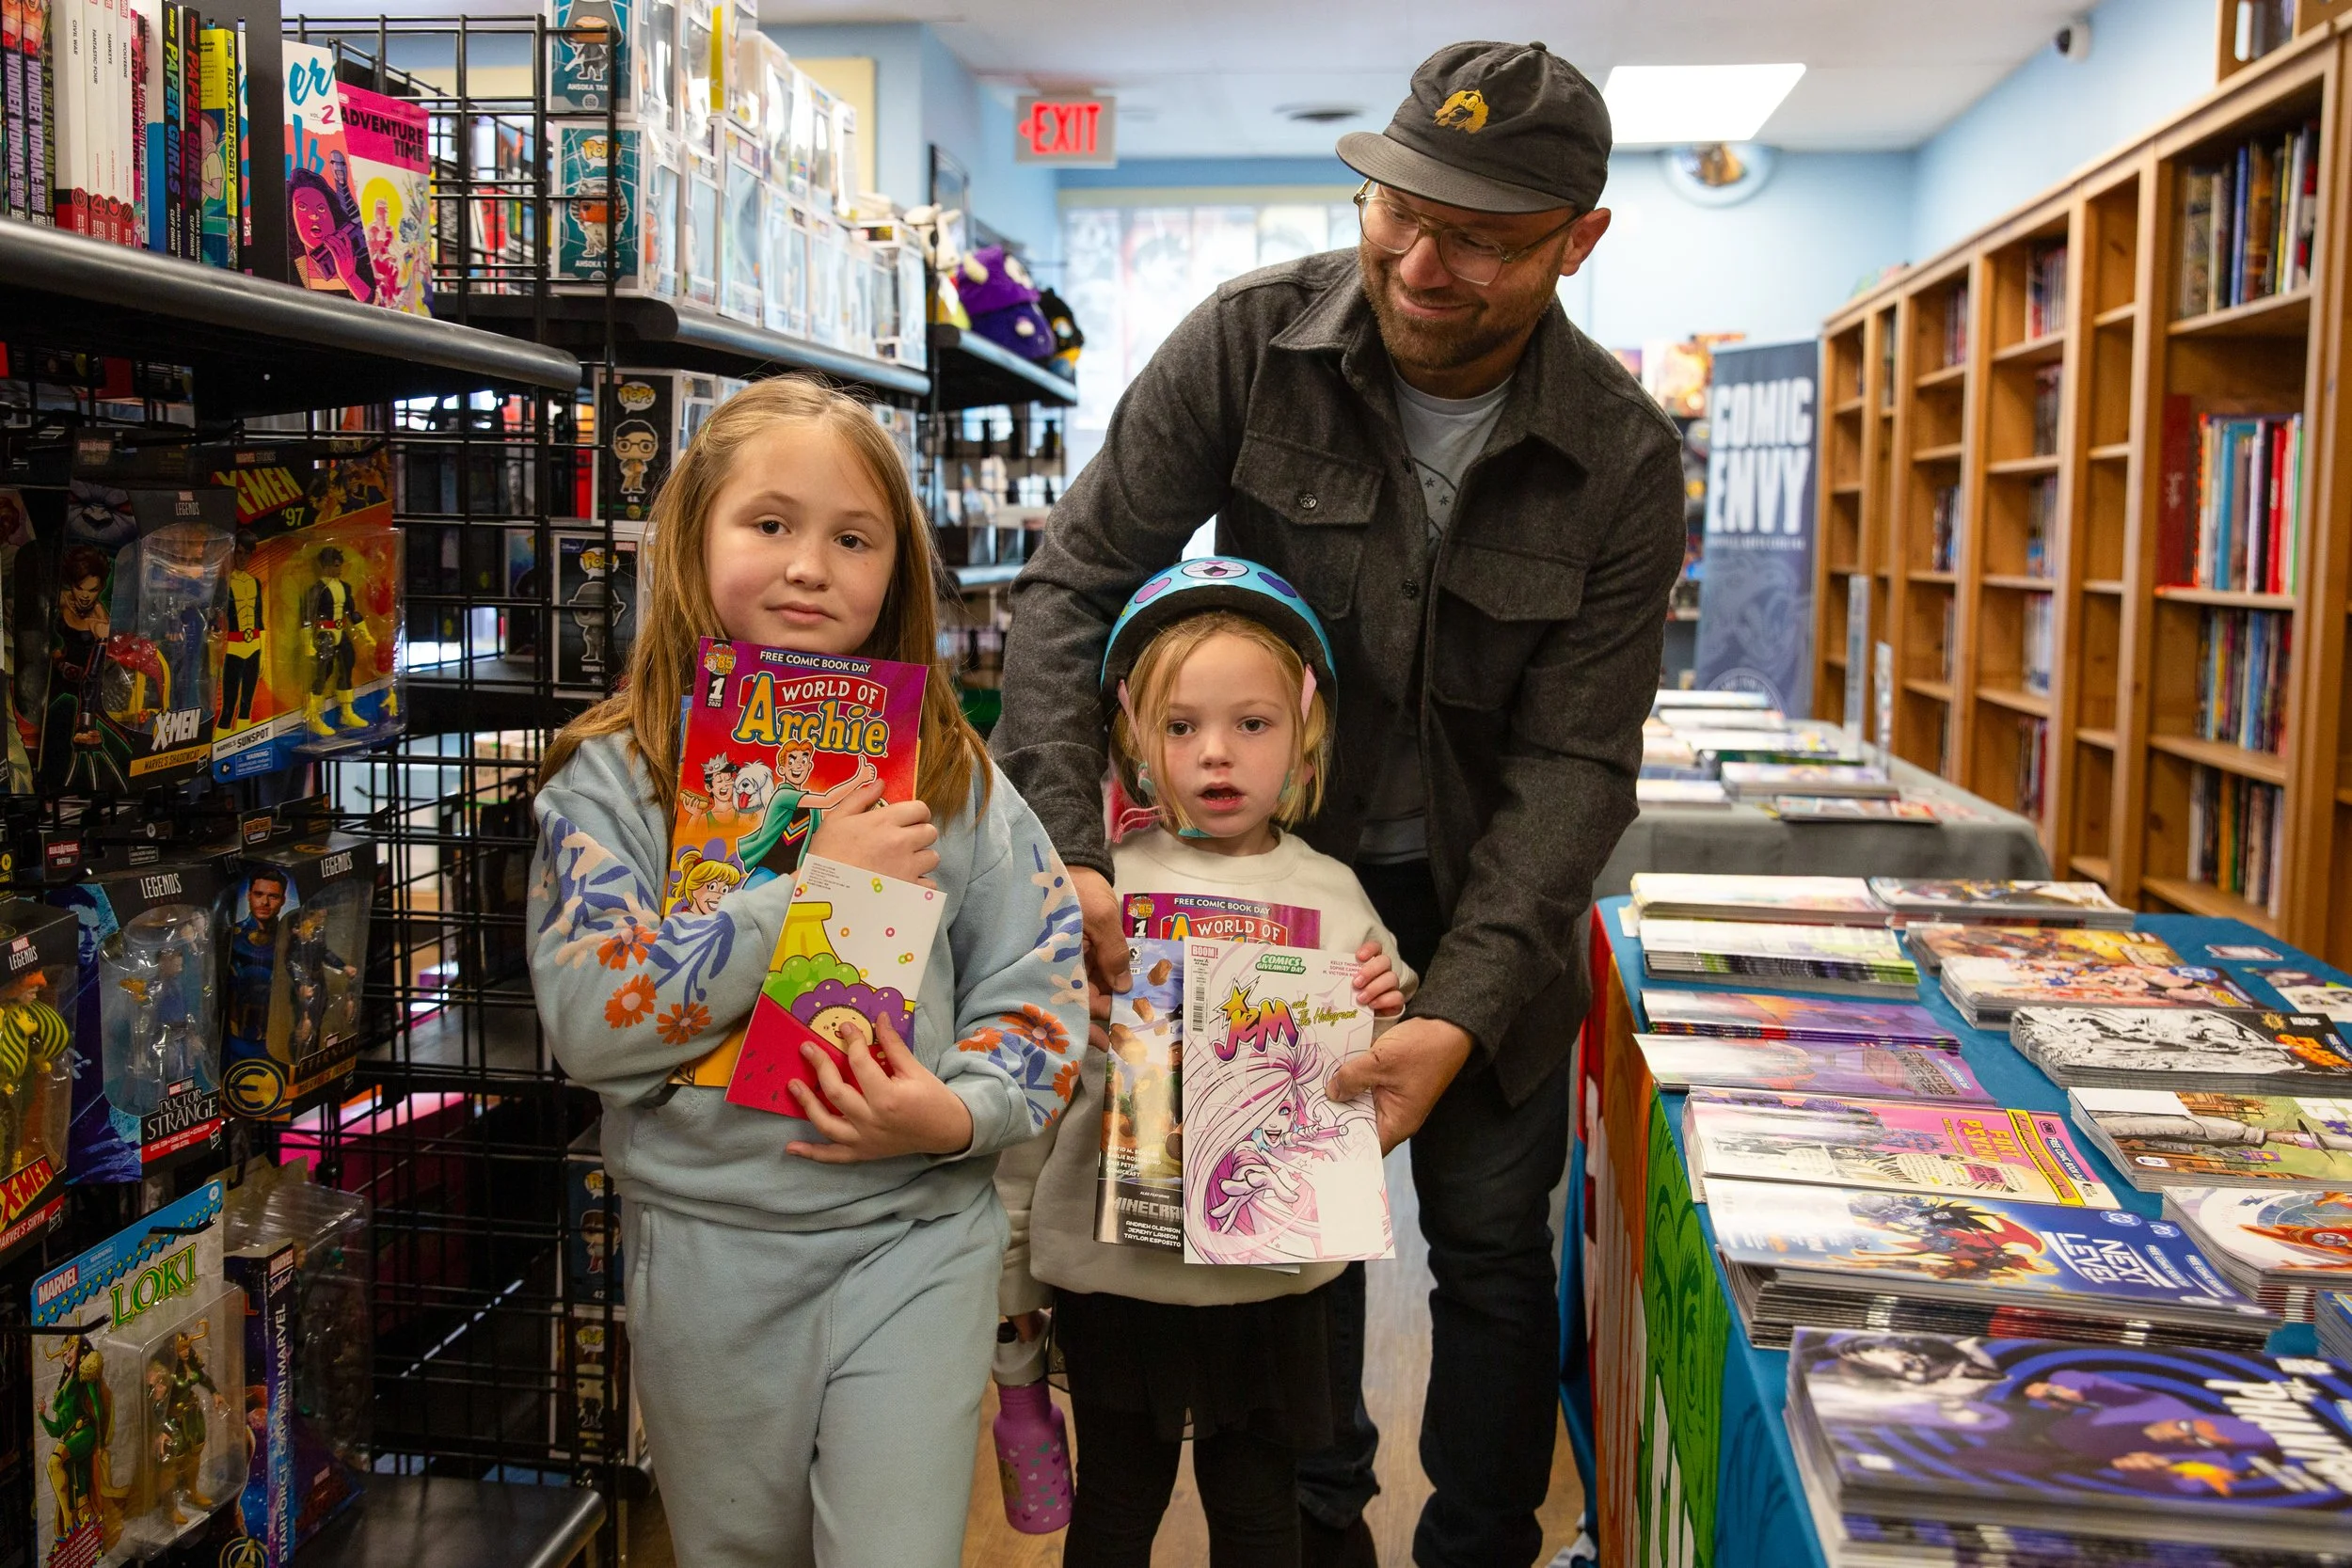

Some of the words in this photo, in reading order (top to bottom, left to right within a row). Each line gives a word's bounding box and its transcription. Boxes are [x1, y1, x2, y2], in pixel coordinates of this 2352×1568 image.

[7, 53, 23, 116] WONDER
[27, 59, 43, 120] WONDER
[166, 41, 180, 119] PAPER
[187, 50, 200, 128] PAPER
[43, 87, 53, 109] THE
[44, 111, 54, 144] LAST
[321, 105, 335, 124] 2
[341, 106, 424, 144] ADVENTURE
[1031, 103, 1102, 155] EXIT
[8, 119, 24, 178] WOMAN:
[29, 124, 45, 182] WOMAN:
[45, 146, 55, 174] MAN
[167, 122, 181, 195] GIRLS
[393, 138, 424, 163] TIME
[188, 132, 201, 201] GIRLS
[38, 184, 46, 212] BLOOD
[618, 384, 655, 404] POP!
[1710, 377, 1814, 449] COMIC
[215, 466, 304, 516] X-MEN
[1706, 448, 1812, 535] ENVY
[175, 502, 200, 516] LEGENDS
[281, 506, 305, 527] '97
[718, 655, 734, 669] 85
[760, 650, 785, 663] FREE
[787, 654, 819, 667] COMIC
[822, 658, 850, 671] BOOK
[851, 662, 871, 673] DAY
[708, 677, 725, 700] 1
[782, 680, 850, 704] WORLD
[857, 685, 880, 705] OF
[733, 673, 889, 756] Archie
[151, 707, 202, 752] X-MEN
[236, 727, 270, 749] SUNSPOT
[143, 755, 168, 771] MARVEL'S
[320, 850, 354, 879] LEGENDS
[140, 873, 183, 899] LEGENDS
[1174, 897, 1195, 906] FREE
[1197, 898, 1225, 909] COMIC
[1228, 902, 1252, 912] BOOK
[1254, 905, 1271, 914] DAY
[1135, 920, 1147, 937] 1
[1197, 918, 1255, 938] WORLD
[1262, 923, 1280, 940] OF
[8, 945, 39, 971] LEGENDS
[1191, 944, 1219, 958] BOOM!
[1261, 954, 1301, 966] COMICS
[1257, 963, 1290, 972] GIVEAWAY
[1292, 993, 1309, 1009] and
[1298, 1008, 1311, 1027] The
[1313, 1006, 1359, 1027] Holograms
[160, 1087, 203, 1114] DOCTOR
[148, 1097, 217, 1141] STRANGE
[1958, 1118, 2002, 1163] PSYCHO
[1986, 1129, 2022, 1158] FORT
[1105, 1167, 1141, 1178] COMICRAFT
[0, 1158, 54, 1223] X-MEN
[1114, 1196, 1184, 1222] INECRA
[0, 1223, 26, 1249] ARVEL'S
[26, 1209, 46, 1234] SIRYN
[1126, 1220, 1152, 1229] ANDREW
[1127, 1227, 1152, 1236] JEREMY
[1152, 1231, 1179, 1241] LAWSON
[1123, 1233, 1149, 1243] TAYLOR
[1149, 1238, 1182, 1247] ESPOSITO
[2057, 1232, 2122, 1285] LEVEL
[2092, 1238, 2162, 1288] NEXT
[39, 1265, 78, 1307] MARVEL
[110, 1243, 197, 1329] LOKI
[275, 1304, 287, 1376] MARVEL
[278, 1465, 289, 1563] STARFORCE
